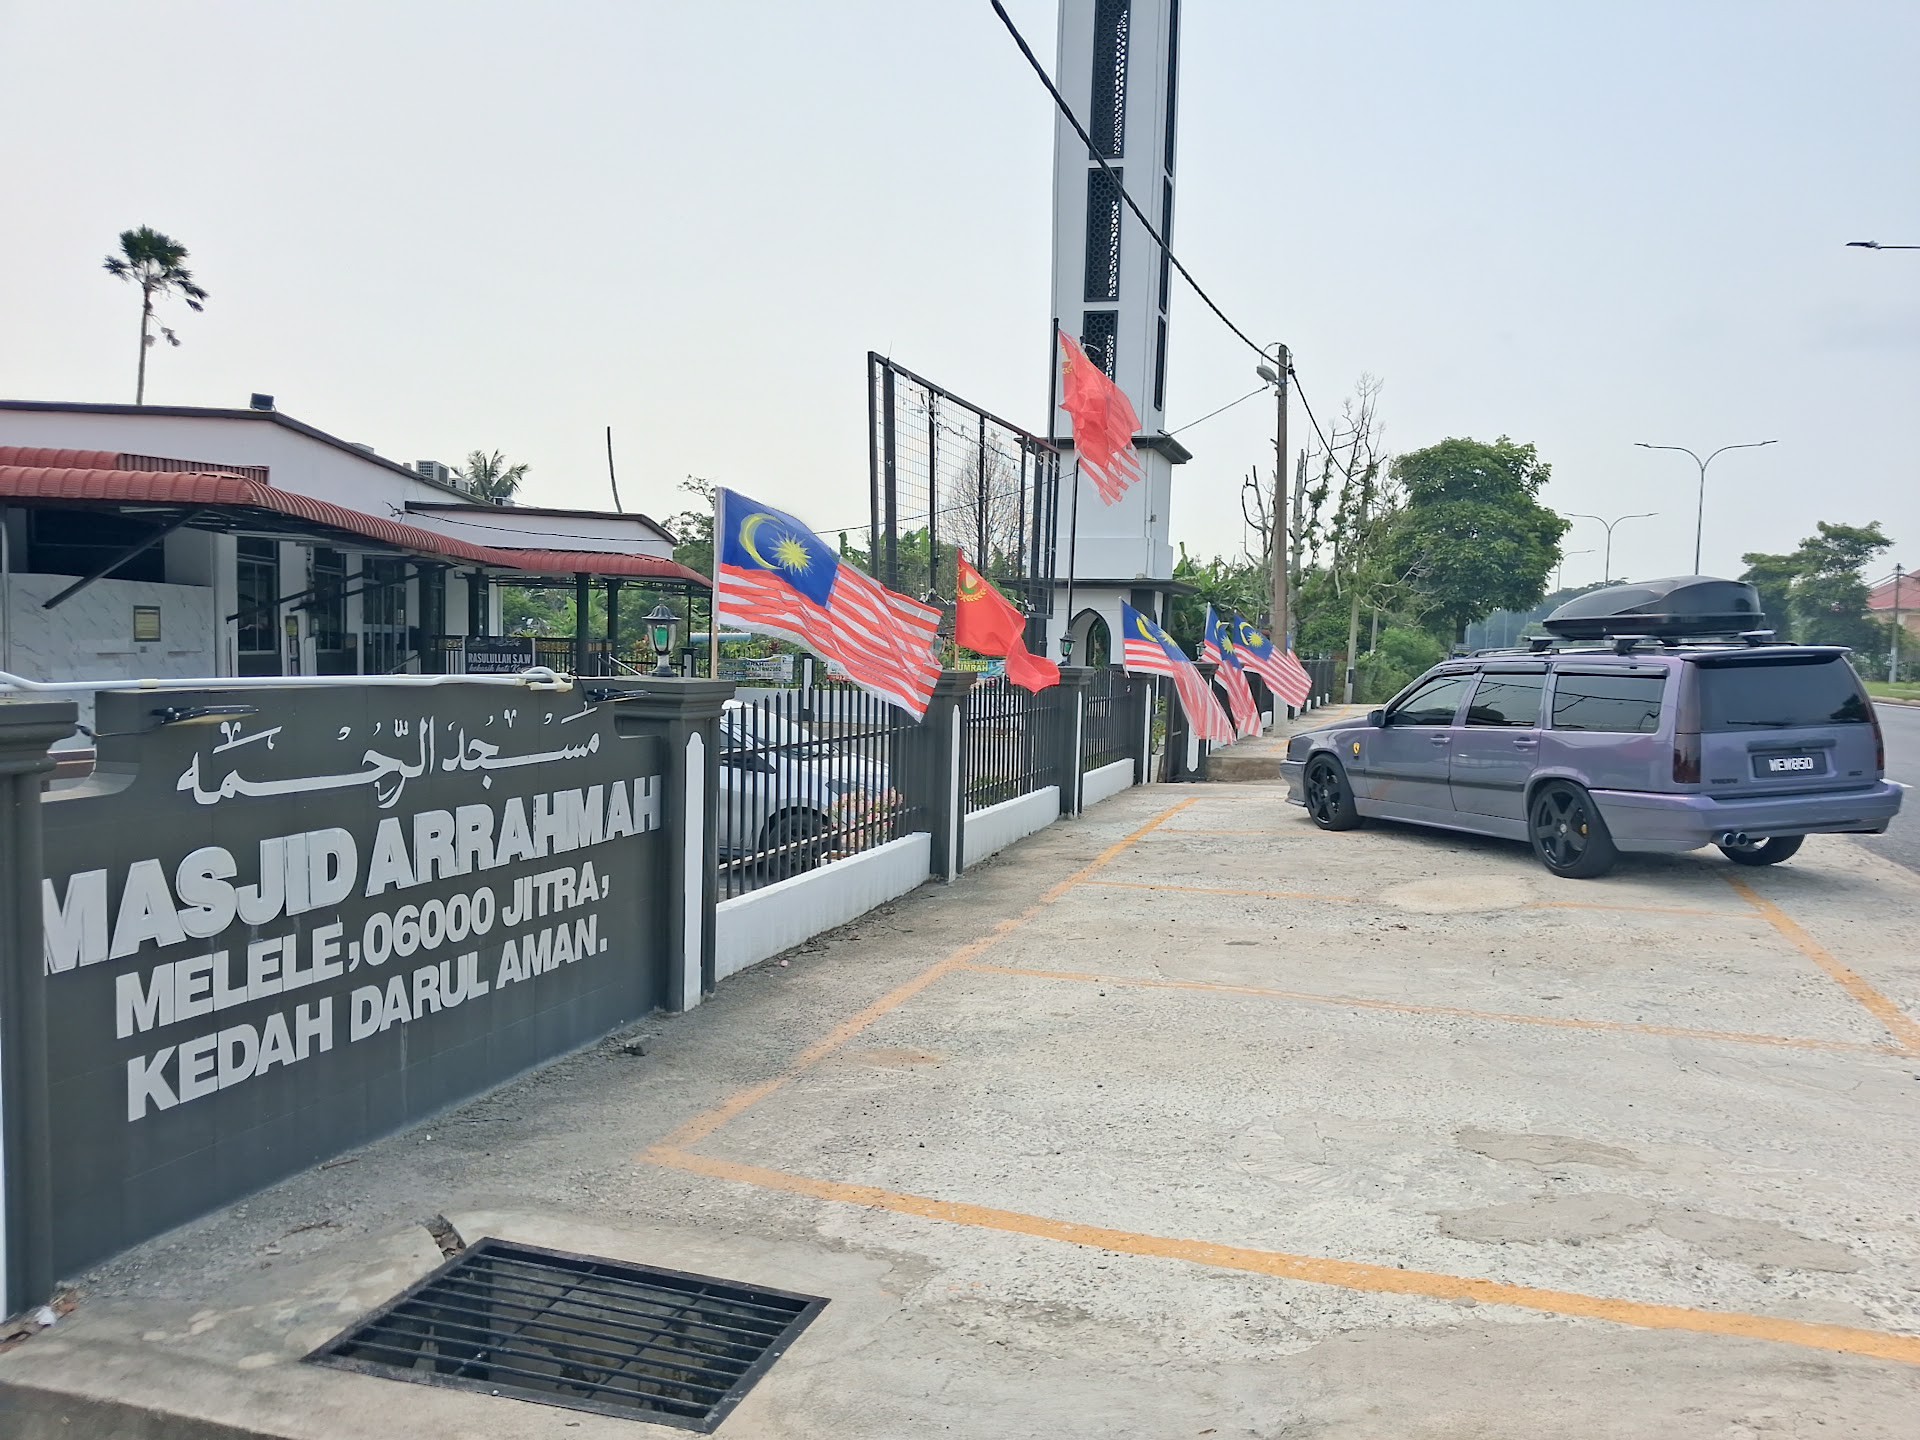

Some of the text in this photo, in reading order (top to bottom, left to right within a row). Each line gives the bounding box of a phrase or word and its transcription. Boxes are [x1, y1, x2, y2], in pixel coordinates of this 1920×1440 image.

[468, 653, 511, 664] RASULULLAH
[957, 663, 988, 672] UMRAH
[42, 775, 661, 976] MASJID ARRAHMAH
[502, 861, 609, 927] JITRA,
[128, 914, 607, 1122] KEDAH DARUL AMAN.
